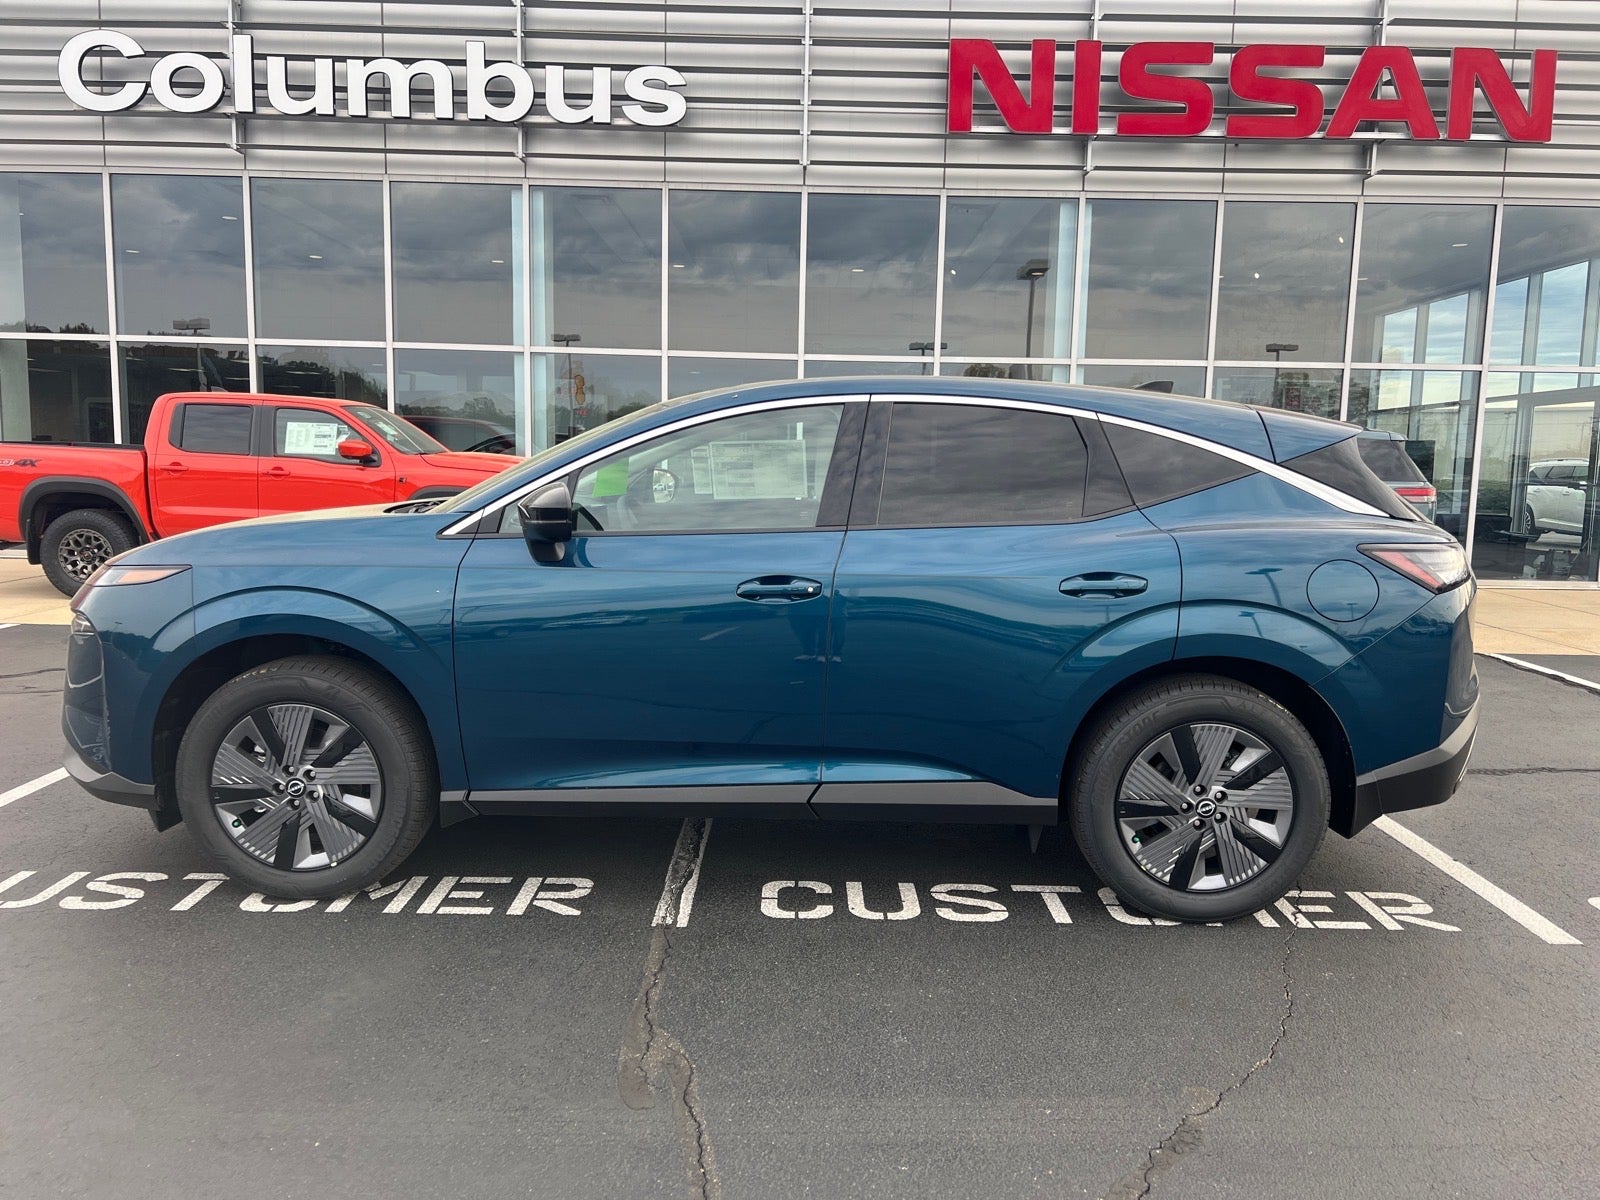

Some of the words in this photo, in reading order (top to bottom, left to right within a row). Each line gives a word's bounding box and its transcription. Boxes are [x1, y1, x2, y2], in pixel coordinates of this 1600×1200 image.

[57, 29, 688, 127] Columbus
[947, 39, 1558, 143] NISSAN
[760, 880, 1462, 932] CUSTER
